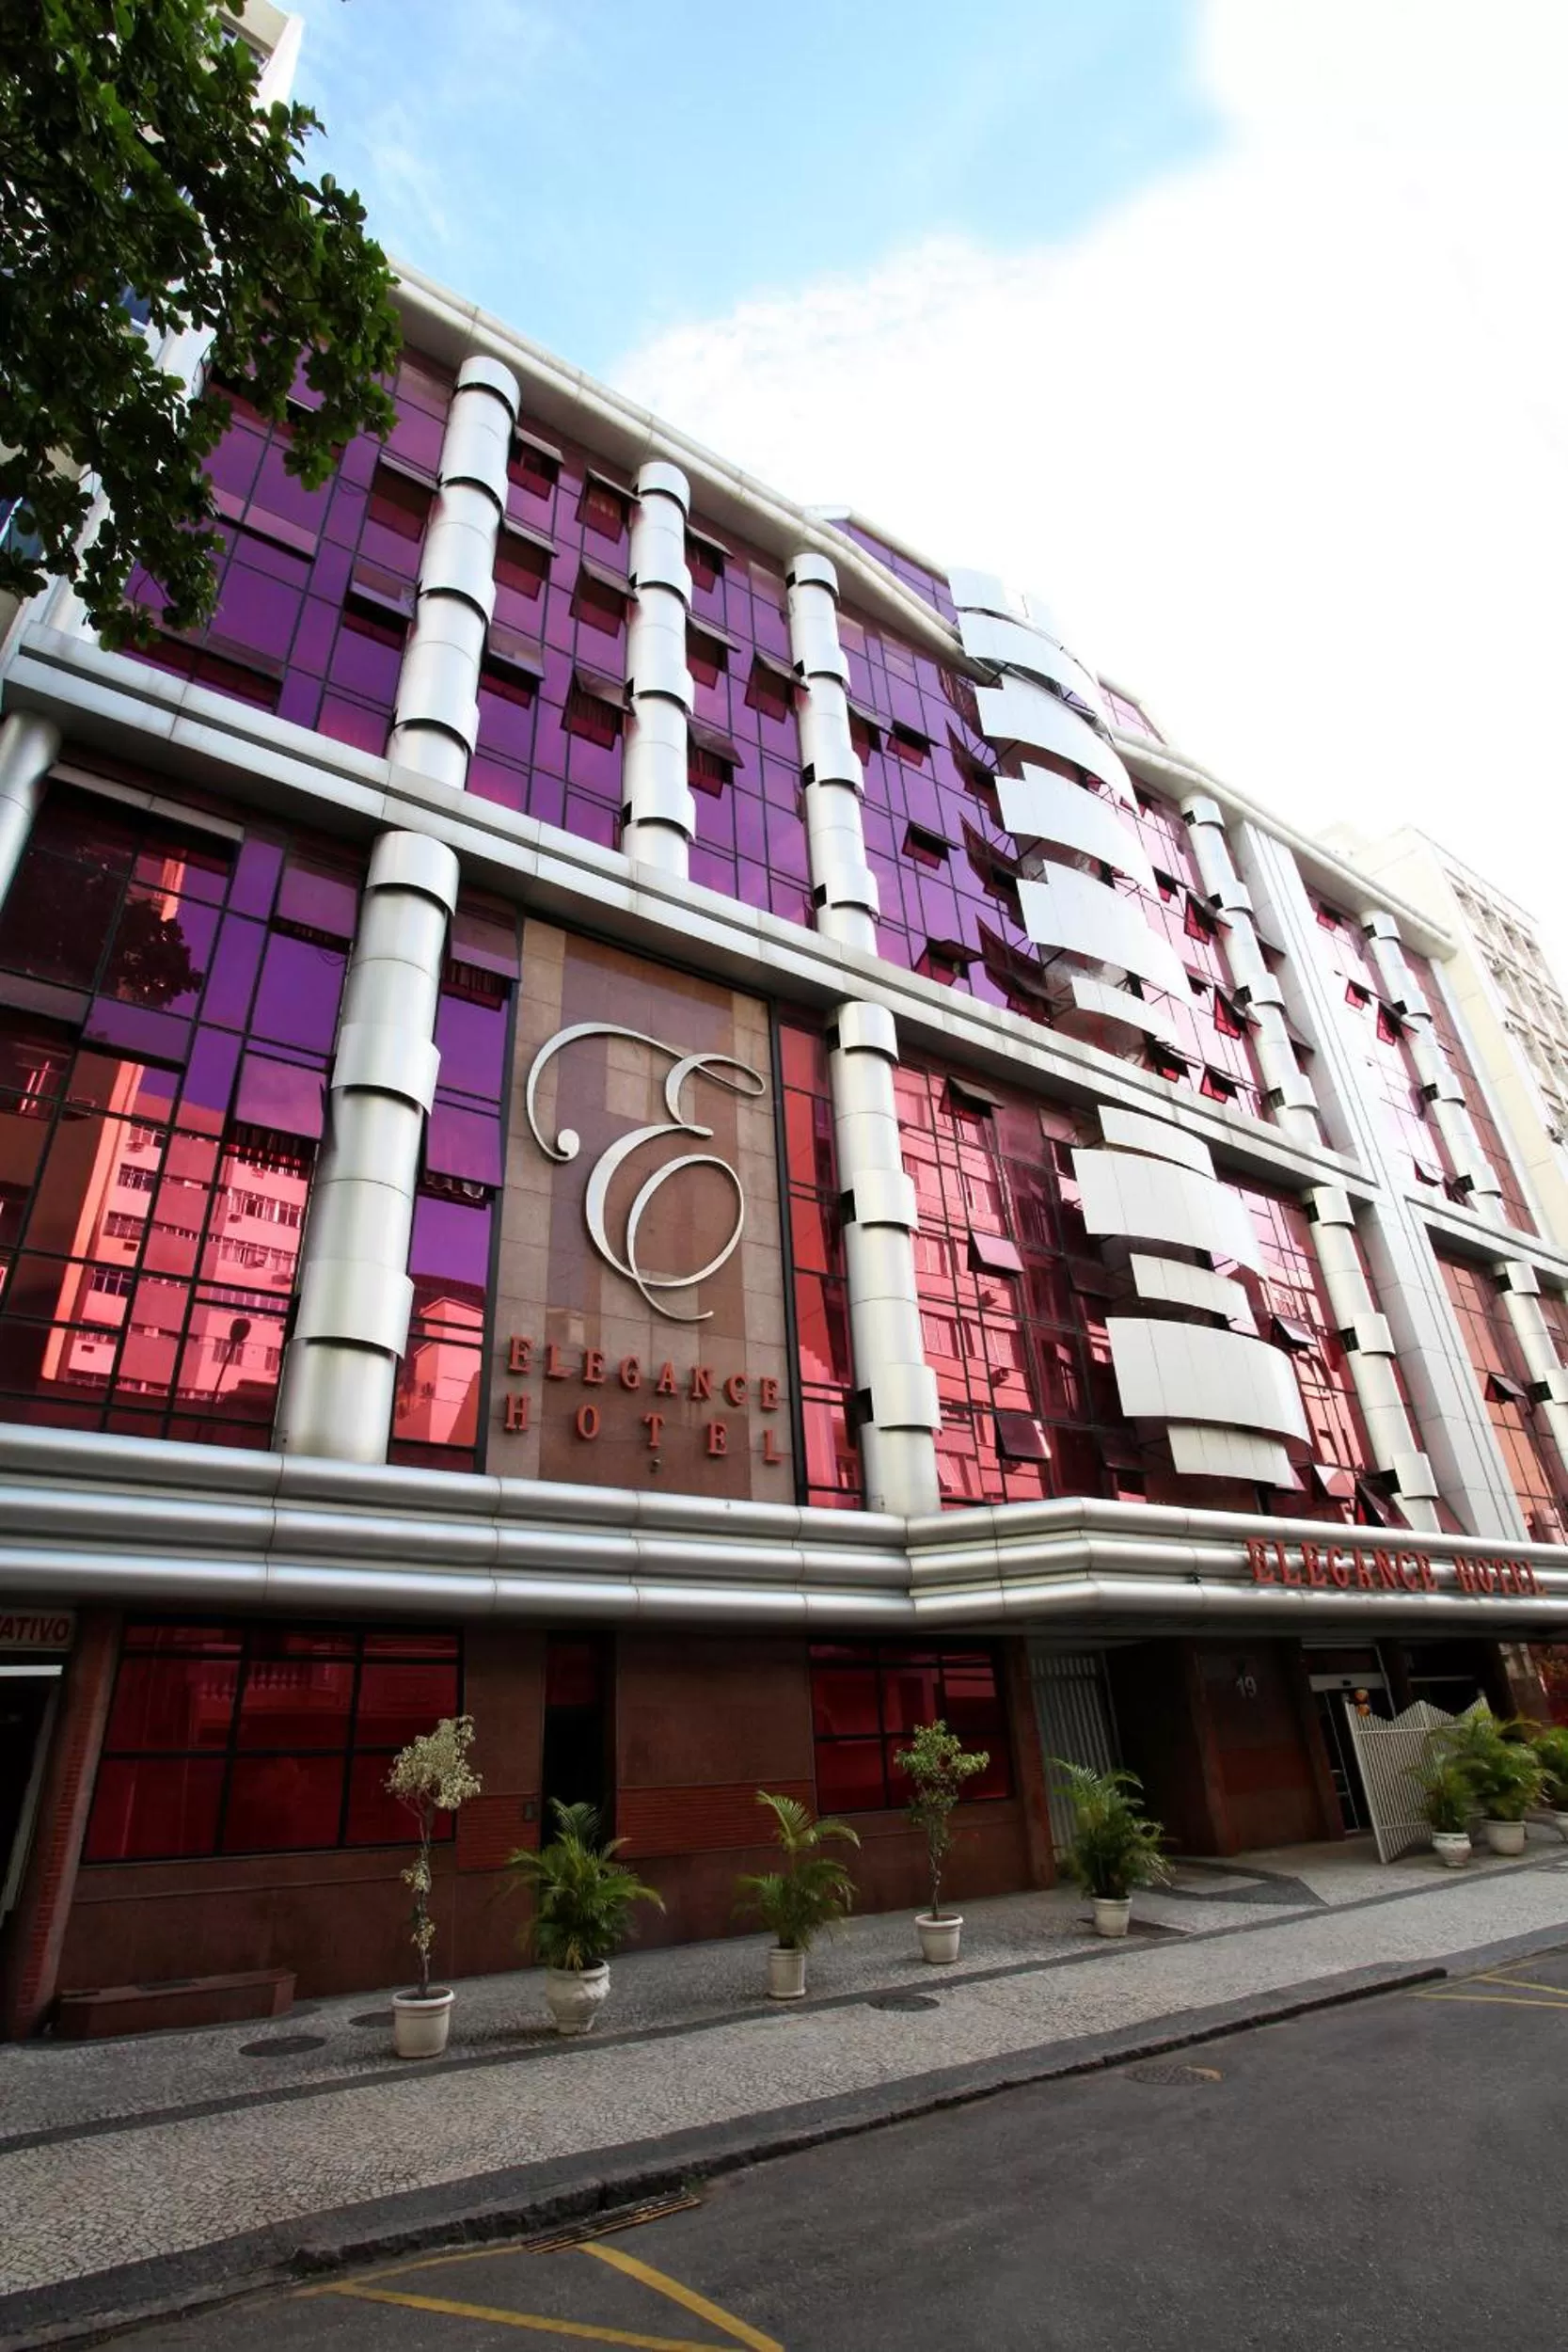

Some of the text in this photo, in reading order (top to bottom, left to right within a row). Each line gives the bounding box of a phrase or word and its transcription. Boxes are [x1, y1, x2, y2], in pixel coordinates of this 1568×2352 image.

[508, 1335, 780, 1410] ELEGANCE
[503, 1391, 782, 1464] HOTEL
[1244, 1537, 1548, 1596] ELEGANCE HOTEL
[0, 1615, 70, 1642] ATIVO
[1237, 1676, 1258, 1700] 19
